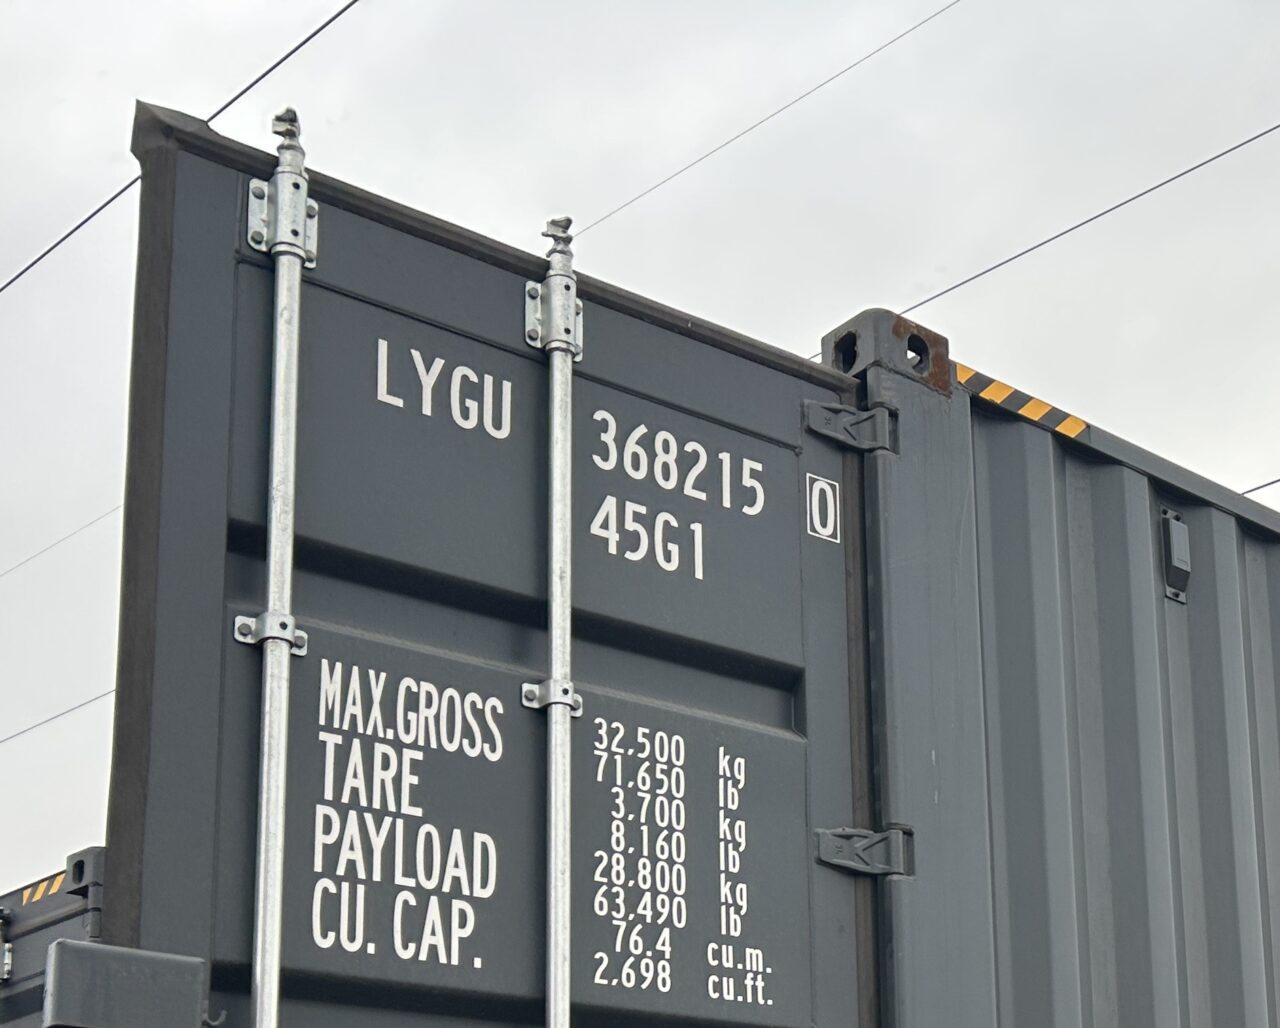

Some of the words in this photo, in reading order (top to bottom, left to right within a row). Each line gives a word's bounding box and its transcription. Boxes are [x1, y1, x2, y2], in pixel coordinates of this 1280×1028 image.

[377, 338, 512, 440] LYGU
[591, 409, 765, 516] 368215
[810, 479, 836, 538] 0
[589, 494, 704, 581] 45G1
[318, 658, 504, 762] MAX.GROSS
[318, 731, 424, 818] TARE
[593, 717, 686, 767] 32,500
[718, 745, 746, 790] kg
[593, 749, 686, 799] 71,650
[718, 777, 740, 811] lb
[313, 803, 497, 899] PAYLOAD
[610, 786, 686, 831] 3,700
[718, 808, 747, 853] kg
[610, 819, 686, 864] 8,160
[719, 840, 741, 874] lb
[593, 849, 687, 896] 28,800
[719, 872, 748, 916] kg
[593, 884, 687, 929] 63,490
[720, 904, 742, 938] lb
[311, 877, 376, 955] CU.
[393, 890, 482, 969] CAP.
[611, 919, 672, 960] 76.4
[706, 942, 773, 974] cu.m.
[593, 951, 672, 993] 2,698
[707, 971, 774, 1006] cu.ft.
